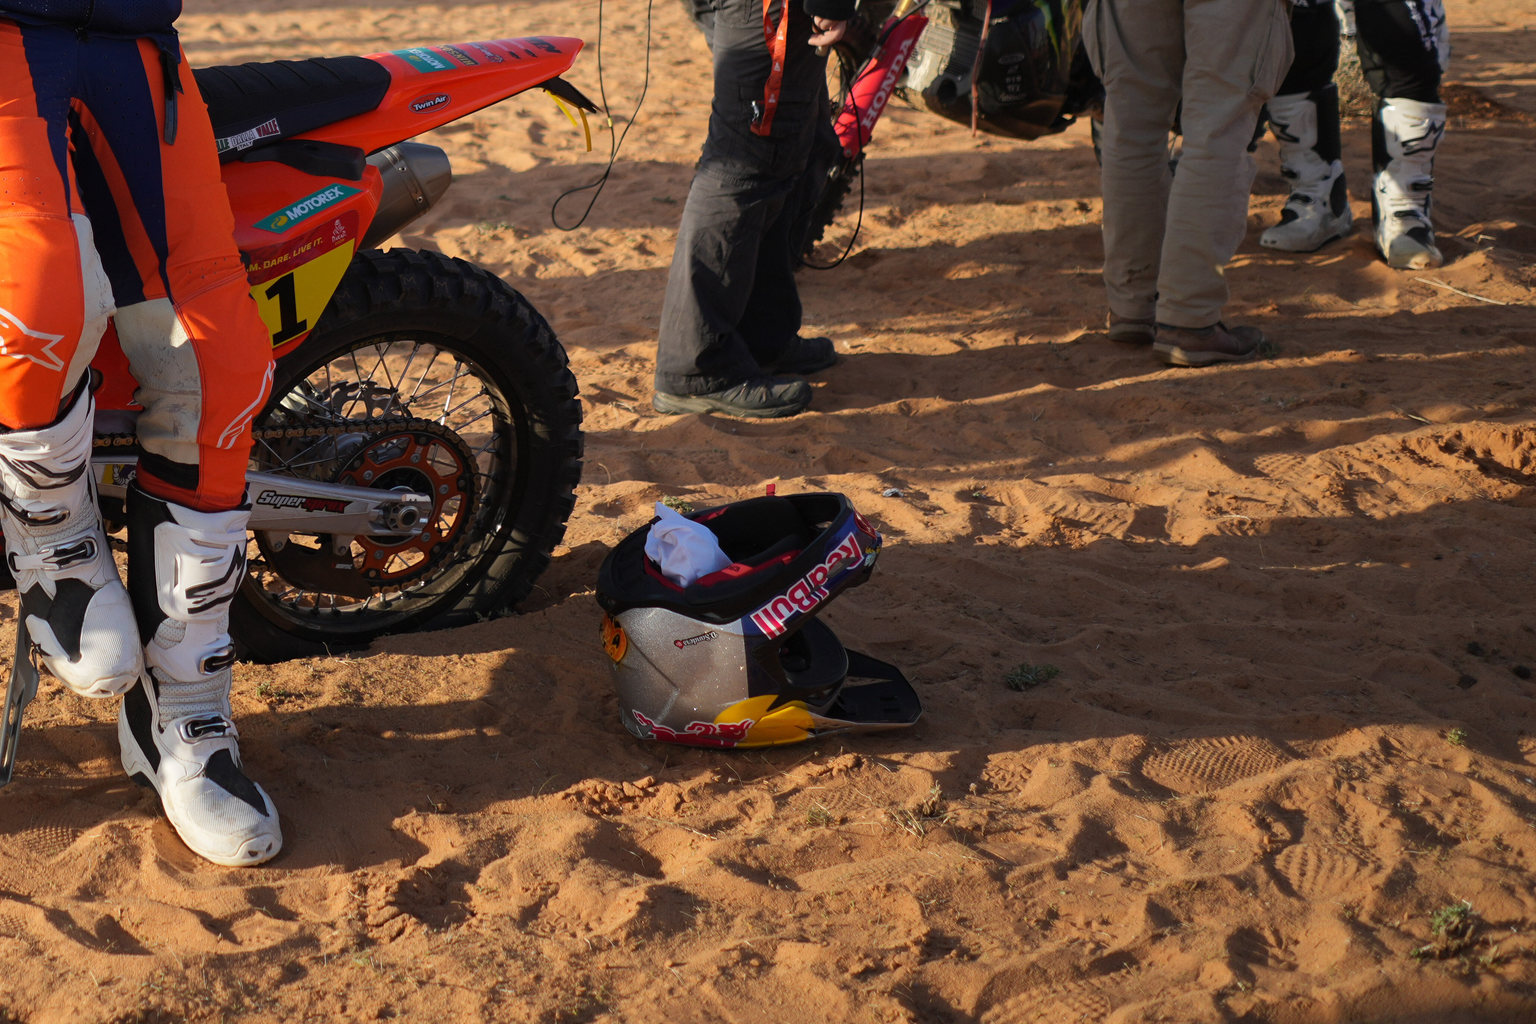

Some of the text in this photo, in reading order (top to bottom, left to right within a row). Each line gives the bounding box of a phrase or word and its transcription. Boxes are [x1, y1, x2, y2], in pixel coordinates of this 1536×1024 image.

[863, 37, 913, 129] HONDA
[413, 95, 447, 112] Twin Air
[285, 185, 345, 221] MOTOREX
[264, 255, 291, 270] DARE.
[293, 244, 313, 258] LIVE
[313, 237, 324, 248] IT.
[264, 272, 309, 346] 1
